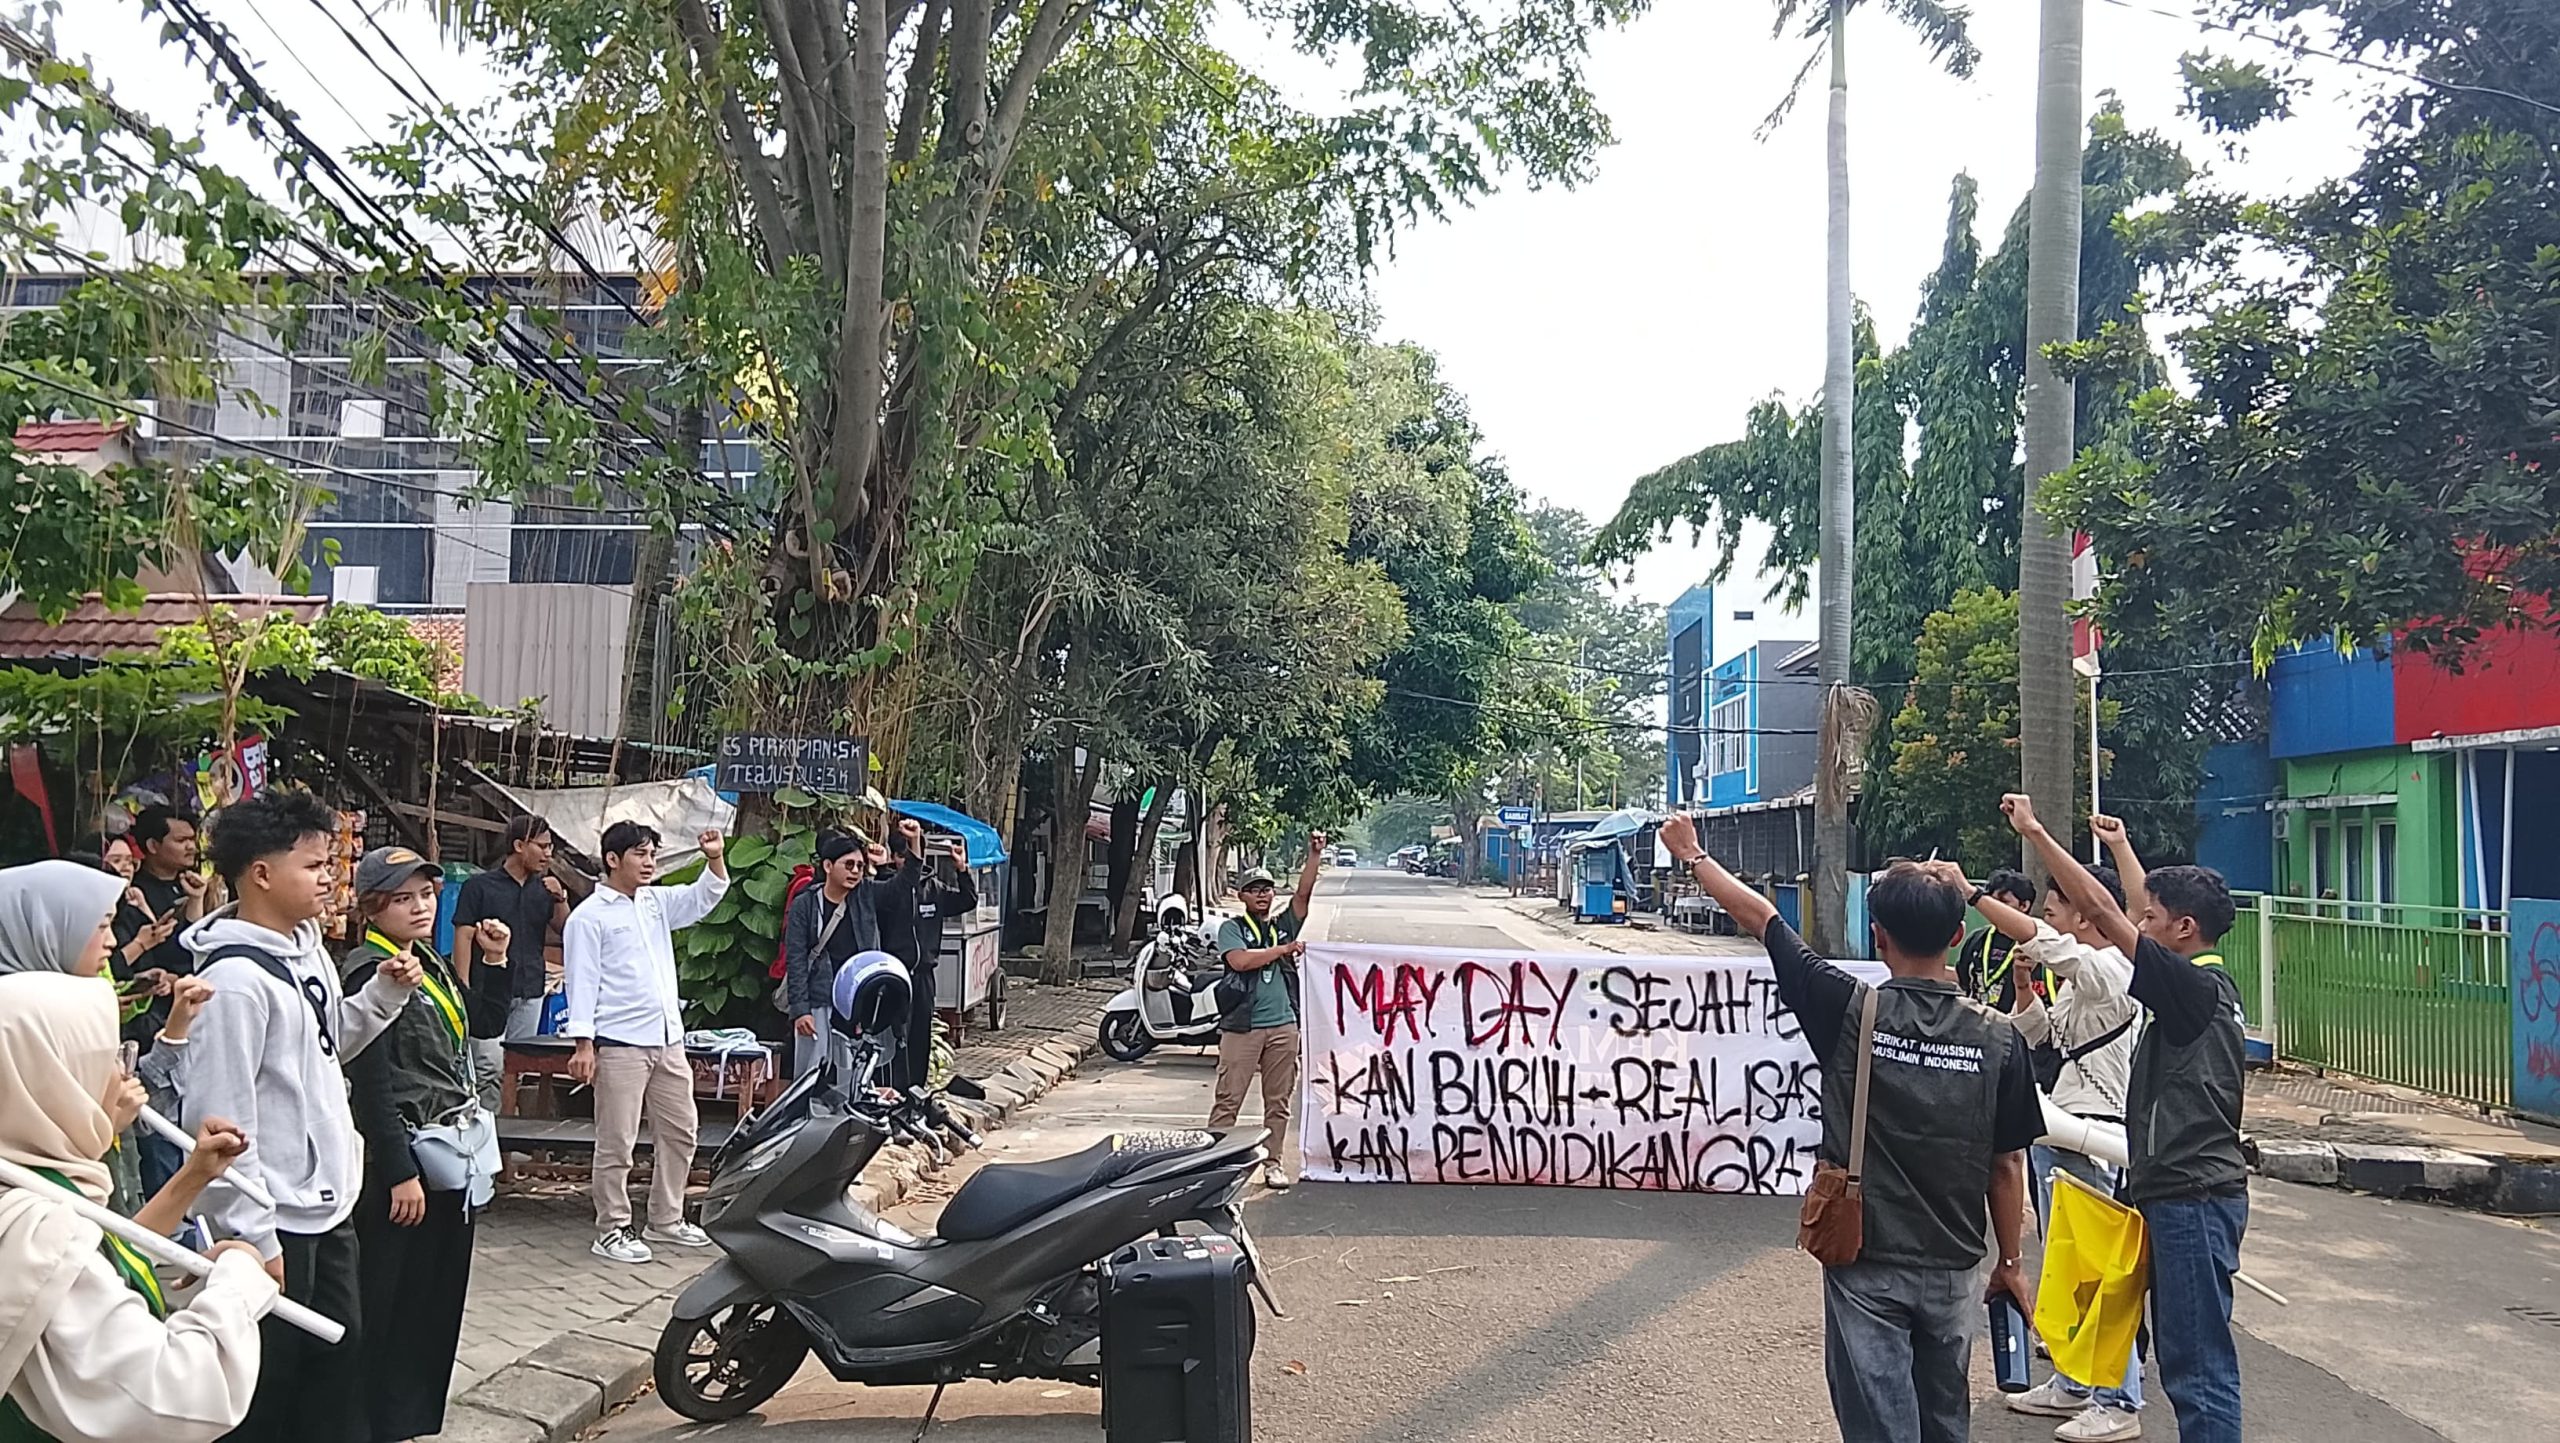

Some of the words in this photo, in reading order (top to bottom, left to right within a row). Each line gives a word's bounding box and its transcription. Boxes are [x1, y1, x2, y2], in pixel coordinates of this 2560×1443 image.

[722, 736, 741, 756] ES
[1333, 962, 1446, 1046] MAY
[1453, 961, 1578, 1055] DAY
[1871, 1045, 1920, 1065] MUSLIMIN
[1924, 1056, 1980, 1073] INDONESIA
[1872, 1031, 1917, 1050] SERIKAT
[1920, 1041, 1983, 1060] MAHASISWA
[1611, 1056, 1822, 1129] REALISAS
[1431, 1121, 1690, 1190] PENDIDIKAN
[1692, 1134, 1821, 1196] GRA
